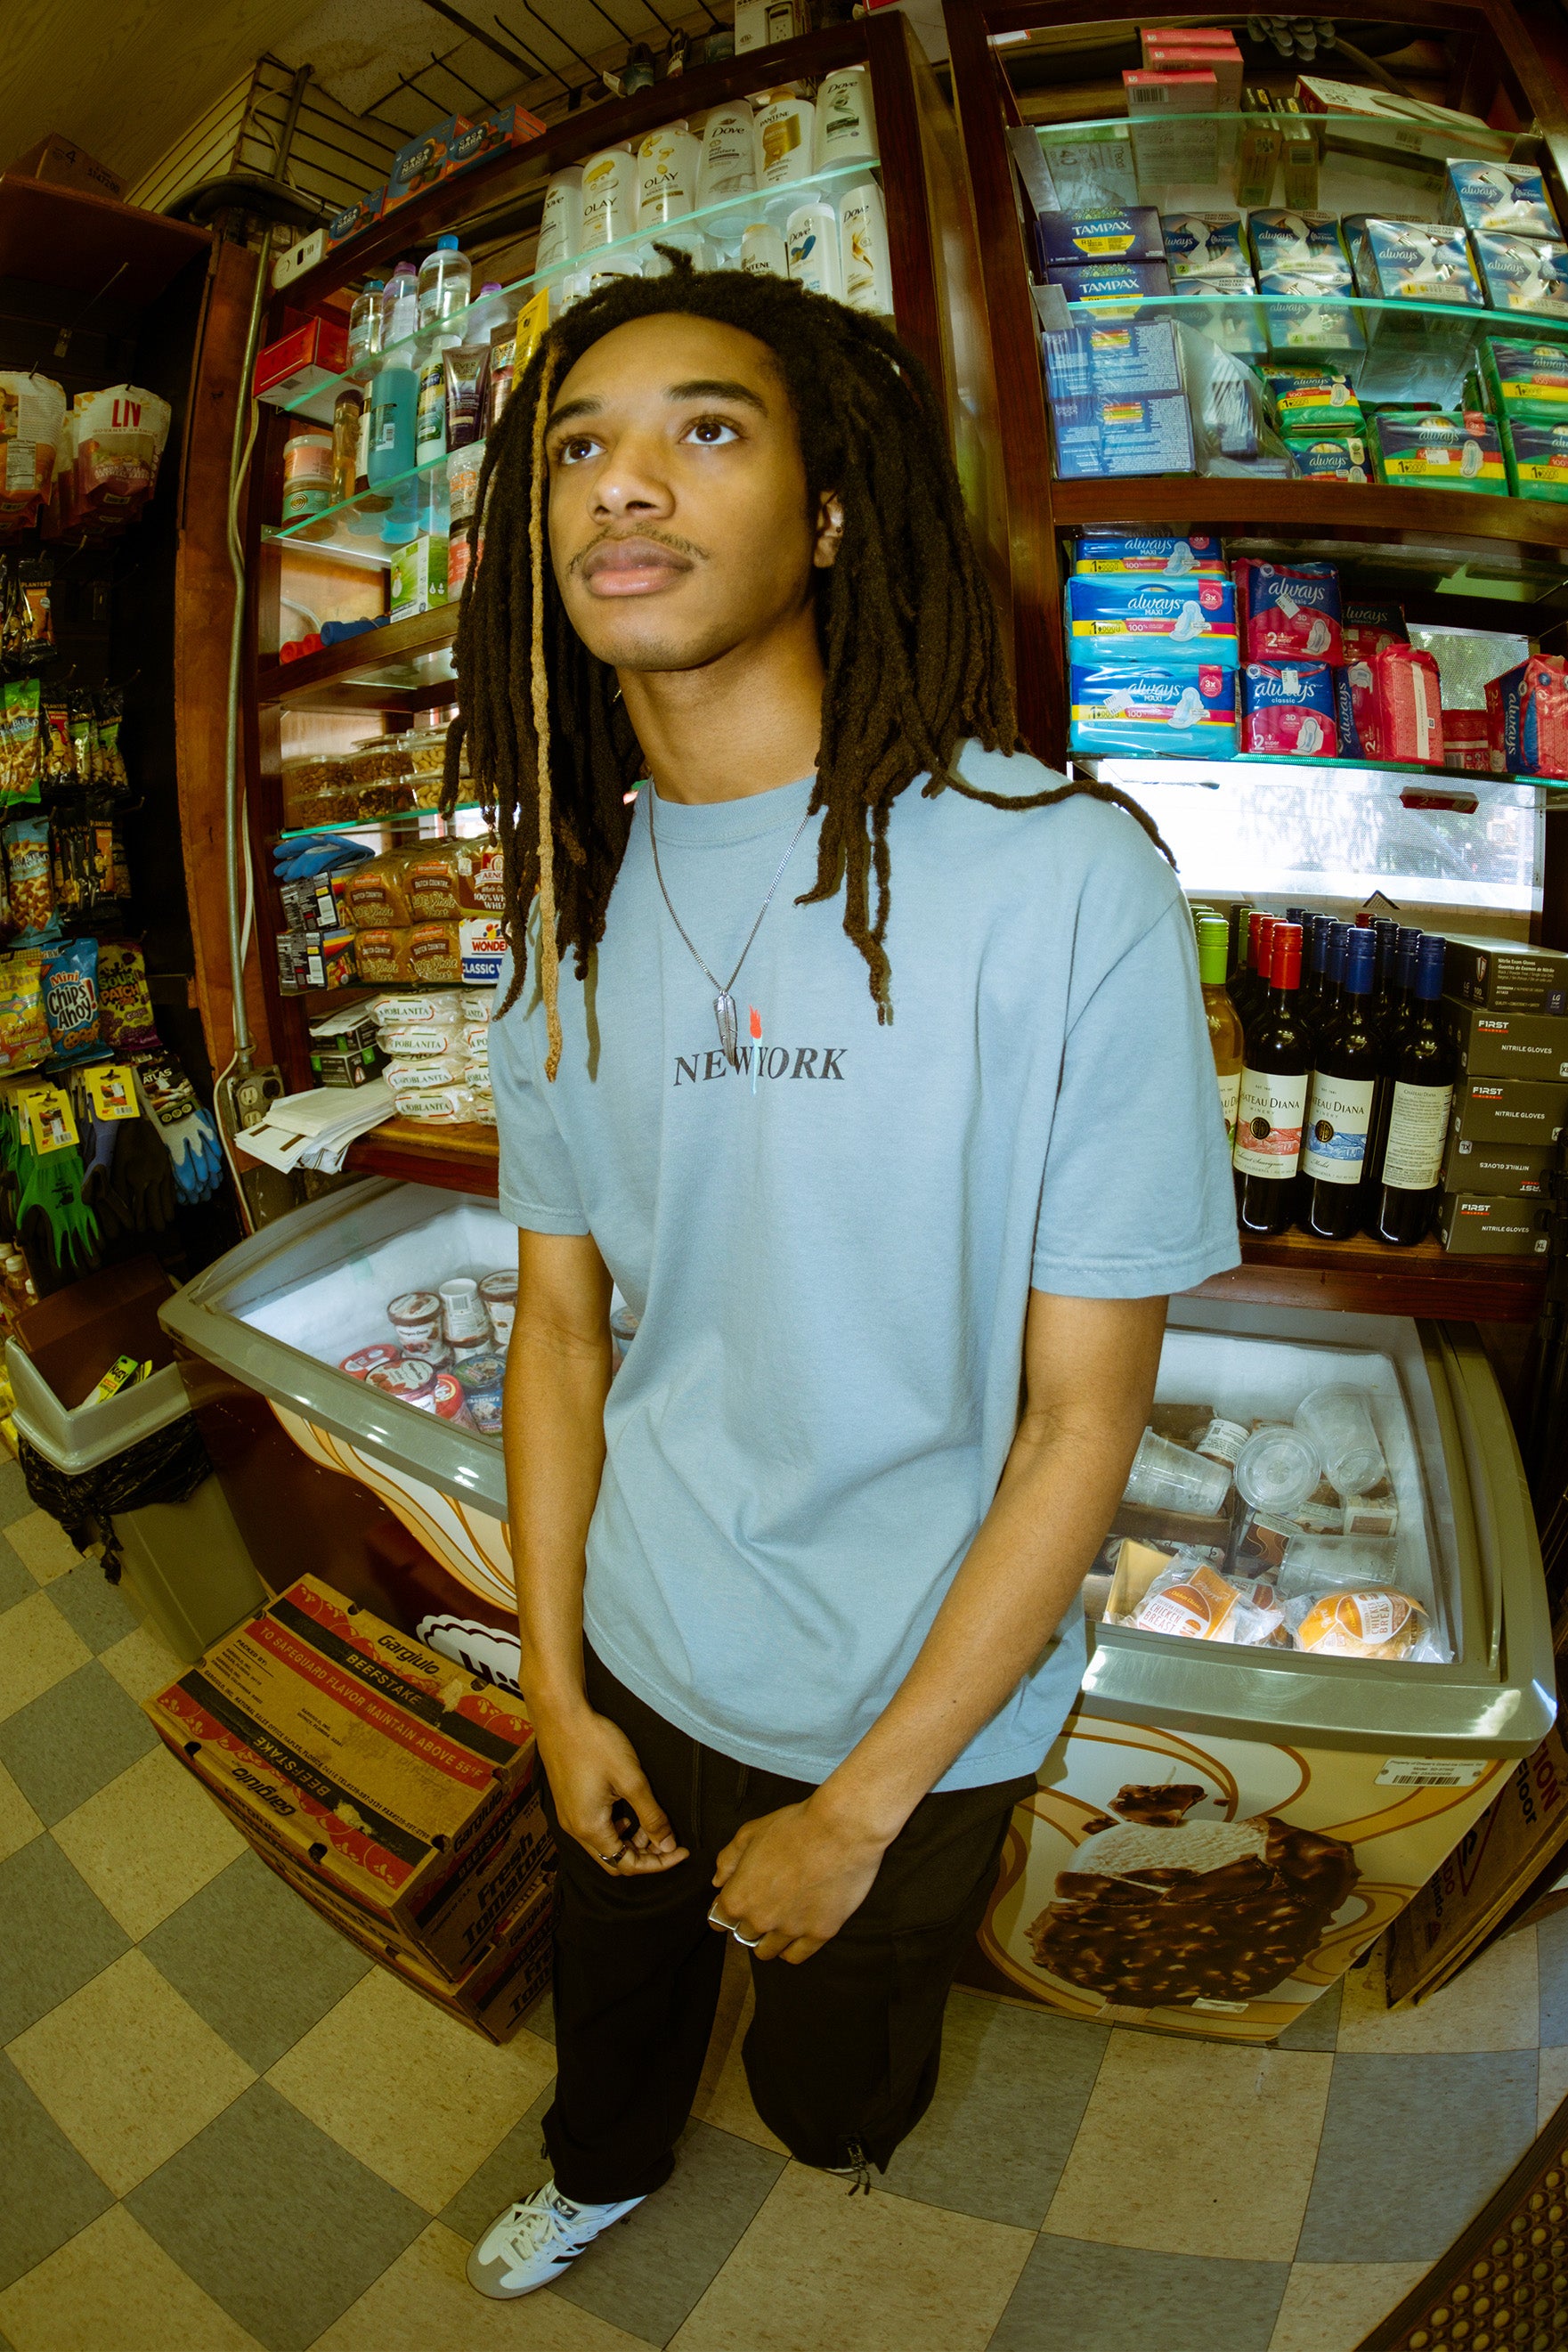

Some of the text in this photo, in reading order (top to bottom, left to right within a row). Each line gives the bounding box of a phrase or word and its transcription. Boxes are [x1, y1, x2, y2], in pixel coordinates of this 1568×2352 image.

[826, 81, 858, 94] Dove
[760, 110, 790, 127] PANTENE
[712, 126, 745, 138] Dove
[644, 172, 678, 190] OLAY
[1460, 185, 1498, 198] always
[584, 197, 617, 216] OLAY
[843, 206, 870, 223] Dove
[789, 227, 811, 245] Dove
[1072, 221, 1132, 236] TAMPAX
[1258, 229, 1294, 244] always
[1378, 248, 1418, 263] always
[1487, 259, 1524, 274] always
[1079, 279, 1140, 294] TAMPAX
[1293, 377, 1329, 386] always
[111, 398, 141, 427] LIV
[1418, 430, 1459, 444] always
[1309, 453, 1347, 468] always
[1125, 538, 1173, 554] always
[1269, 578, 1325, 605] always
[1127, 594, 1216, 615] always 3x
[1267, 631, 1278, 647] 2
[1127, 680, 1216, 701] always 3x
[1255, 670, 1316, 703] alwys
[1339, 682, 1353, 745] always
[1505, 693, 1520, 755] always
[1254, 735, 1265, 751] 2
[1365, 740, 1377, 753] 2
[415, 878, 448, 888] DUTCH COUNTRY
[474, 893, 492, 901] 100%
[462, 964, 495, 975] CLASSIC
[50, 970, 80, 987] Mini
[99, 971, 136, 990] SOUR
[47, 983, 87, 1017] Chips
[101, 984, 140, 1005] PATCH
[1552, 994, 1561, 1002] LG
[394, 1040, 442, 1049] POBLANITA
[1527, 1046, 1553, 1054] GLOVES
[673, 1046, 849, 1086] NEW YORK
[143, 1068, 173, 1084] ATLAS
[403, 1074, 450, 1084] POBLANITA
[1270, 1097, 1300, 1109] DIANA
[1334, 1101, 1364, 1115] DIANA
[1520, 1111, 1545, 1119] GLOVES
[1480, 1161, 1504, 1169] GLOVES
[1506, 1225, 1530, 1233] GLOVES
[1143, 1611, 1175, 1633] BREAST
[1150, 1604, 1182, 1624] CHICKEN
[236, 1640, 260, 1661] PACKED
[378, 1634, 441, 1675] Gargiulo
[345, 1654, 423, 1707] BEEFSTAKE
[260, 1627, 275, 1640] TO
[273, 1637, 328, 1680] SAFEGUARD
[326, 1676, 366, 1707] FLAVOR
[363, 1699, 418, 1741] MAINTAIN
[415, 1735, 456, 1767] ABOVE
[252, 1736, 332, 1798] BEEFSTAKE
[232, 1767, 297, 1819] Gargiulo
[1515, 1758, 1537, 1825] Floor
[453, 1789, 504, 1853] Gargiulo
[477, 1832, 533, 1910] Fresh
